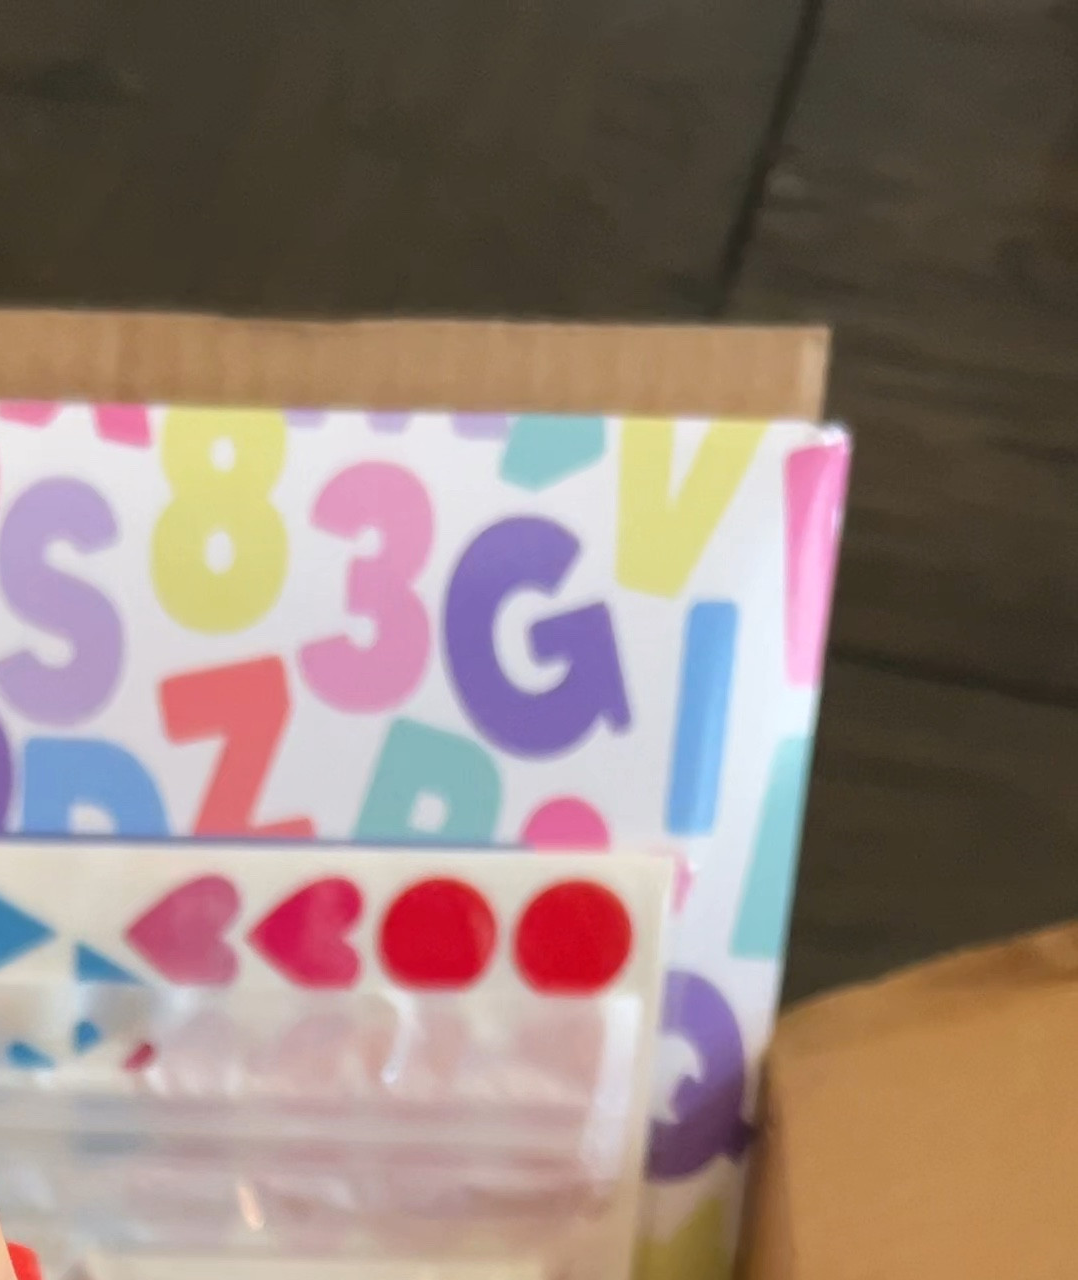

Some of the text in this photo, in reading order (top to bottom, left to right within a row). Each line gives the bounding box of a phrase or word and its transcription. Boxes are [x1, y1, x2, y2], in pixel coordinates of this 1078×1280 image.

[150, 405, 288, 635] 8
[298, 460, 434, 714] 3
[443, 514, 631, 760] G
